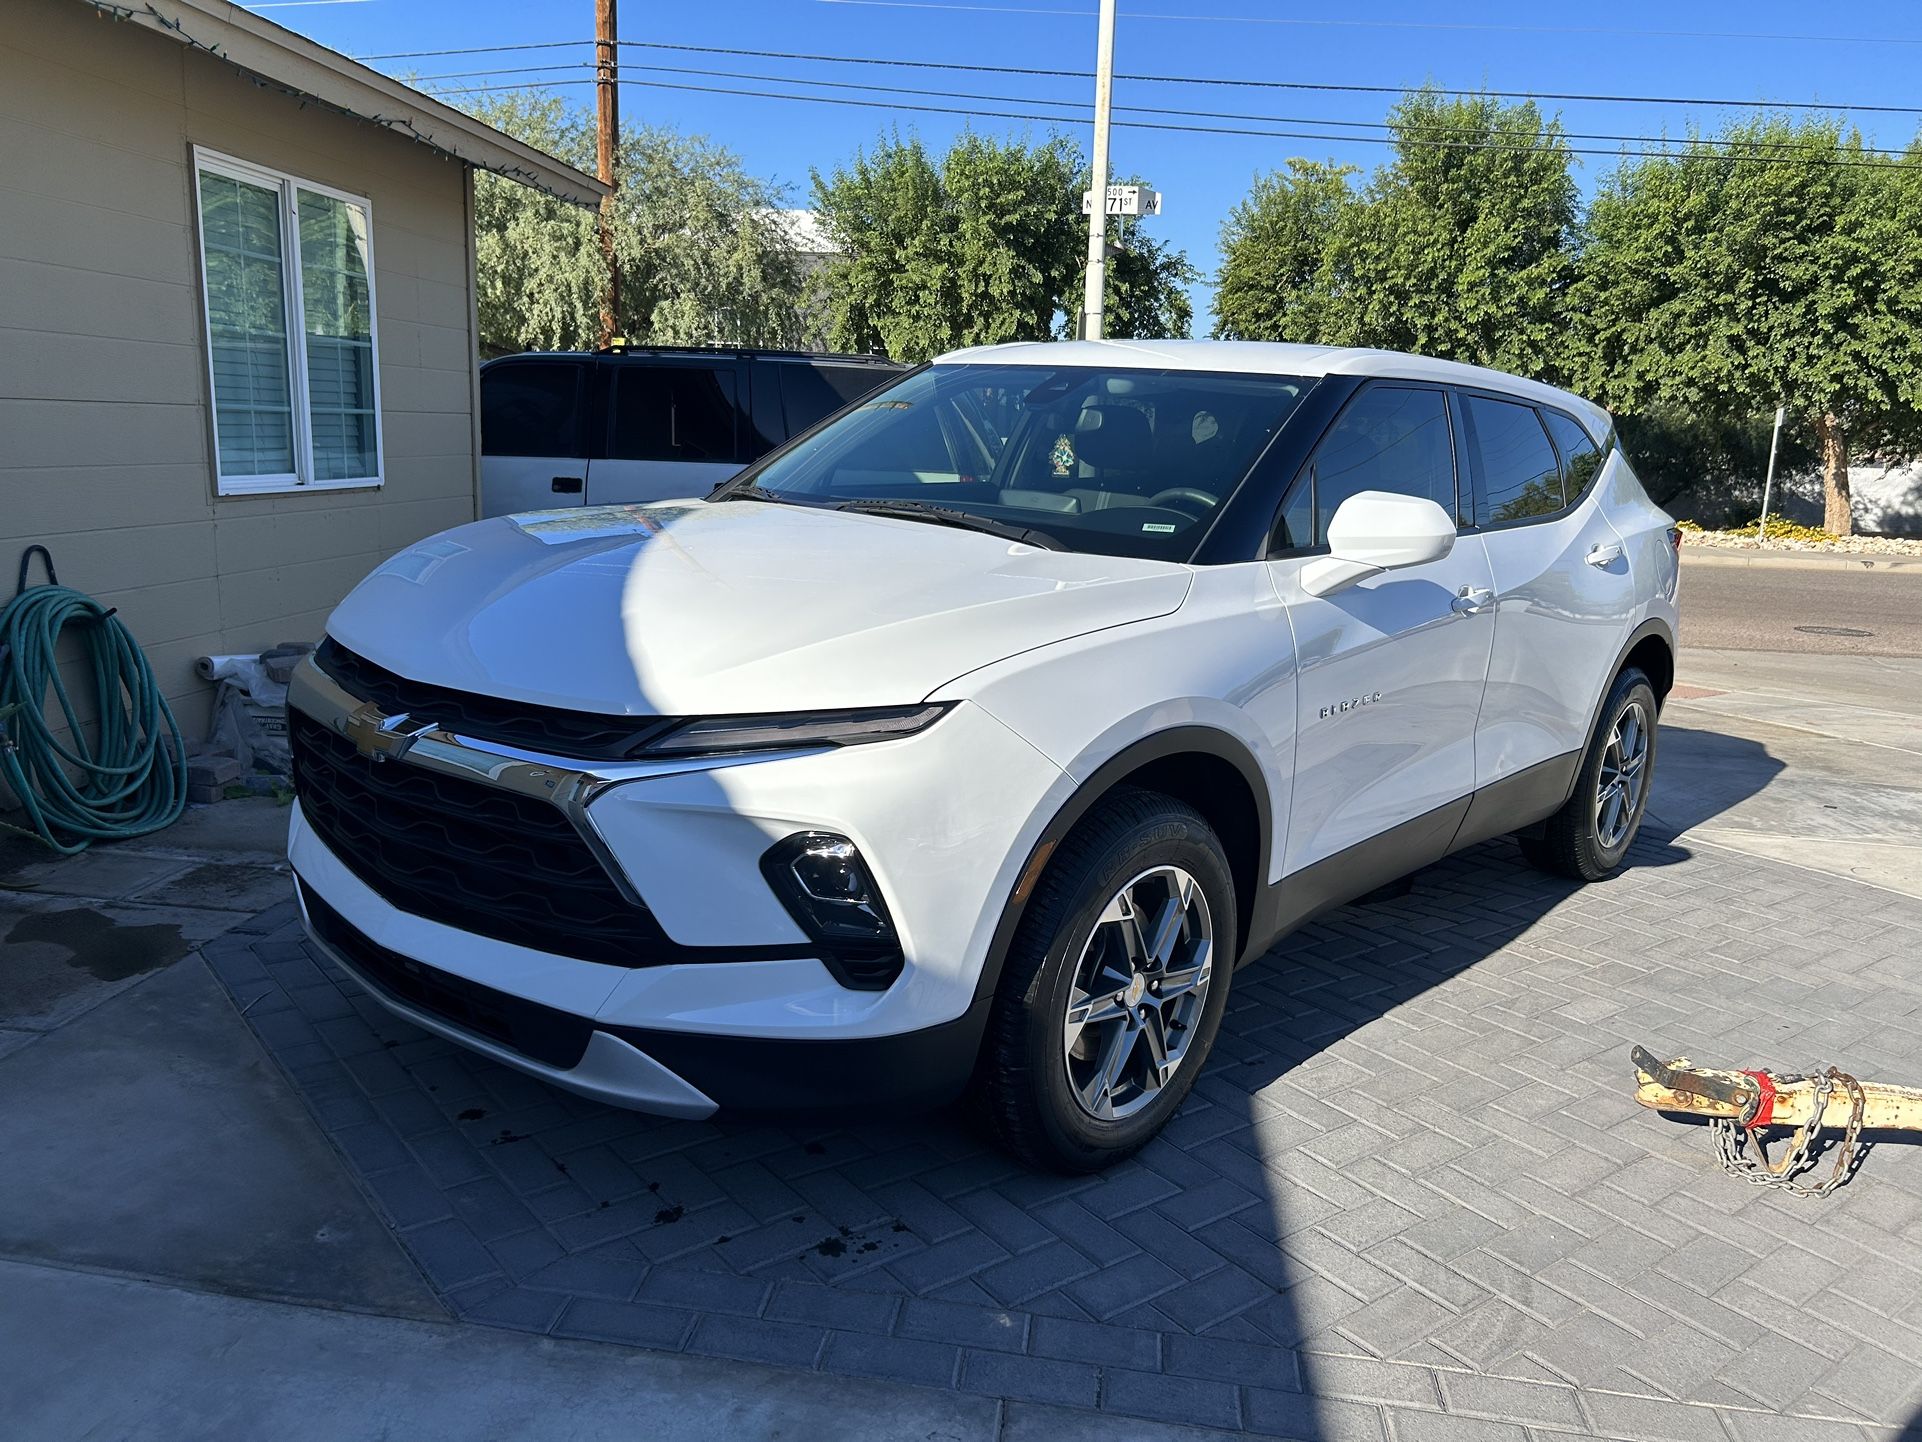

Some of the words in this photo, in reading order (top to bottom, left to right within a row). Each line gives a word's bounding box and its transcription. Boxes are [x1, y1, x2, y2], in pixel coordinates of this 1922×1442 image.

[1107, 187, 1123, 197] 500
[1145, 200, 1159, 210] AV
[1319, 692, 1382, 719] BLAZER
